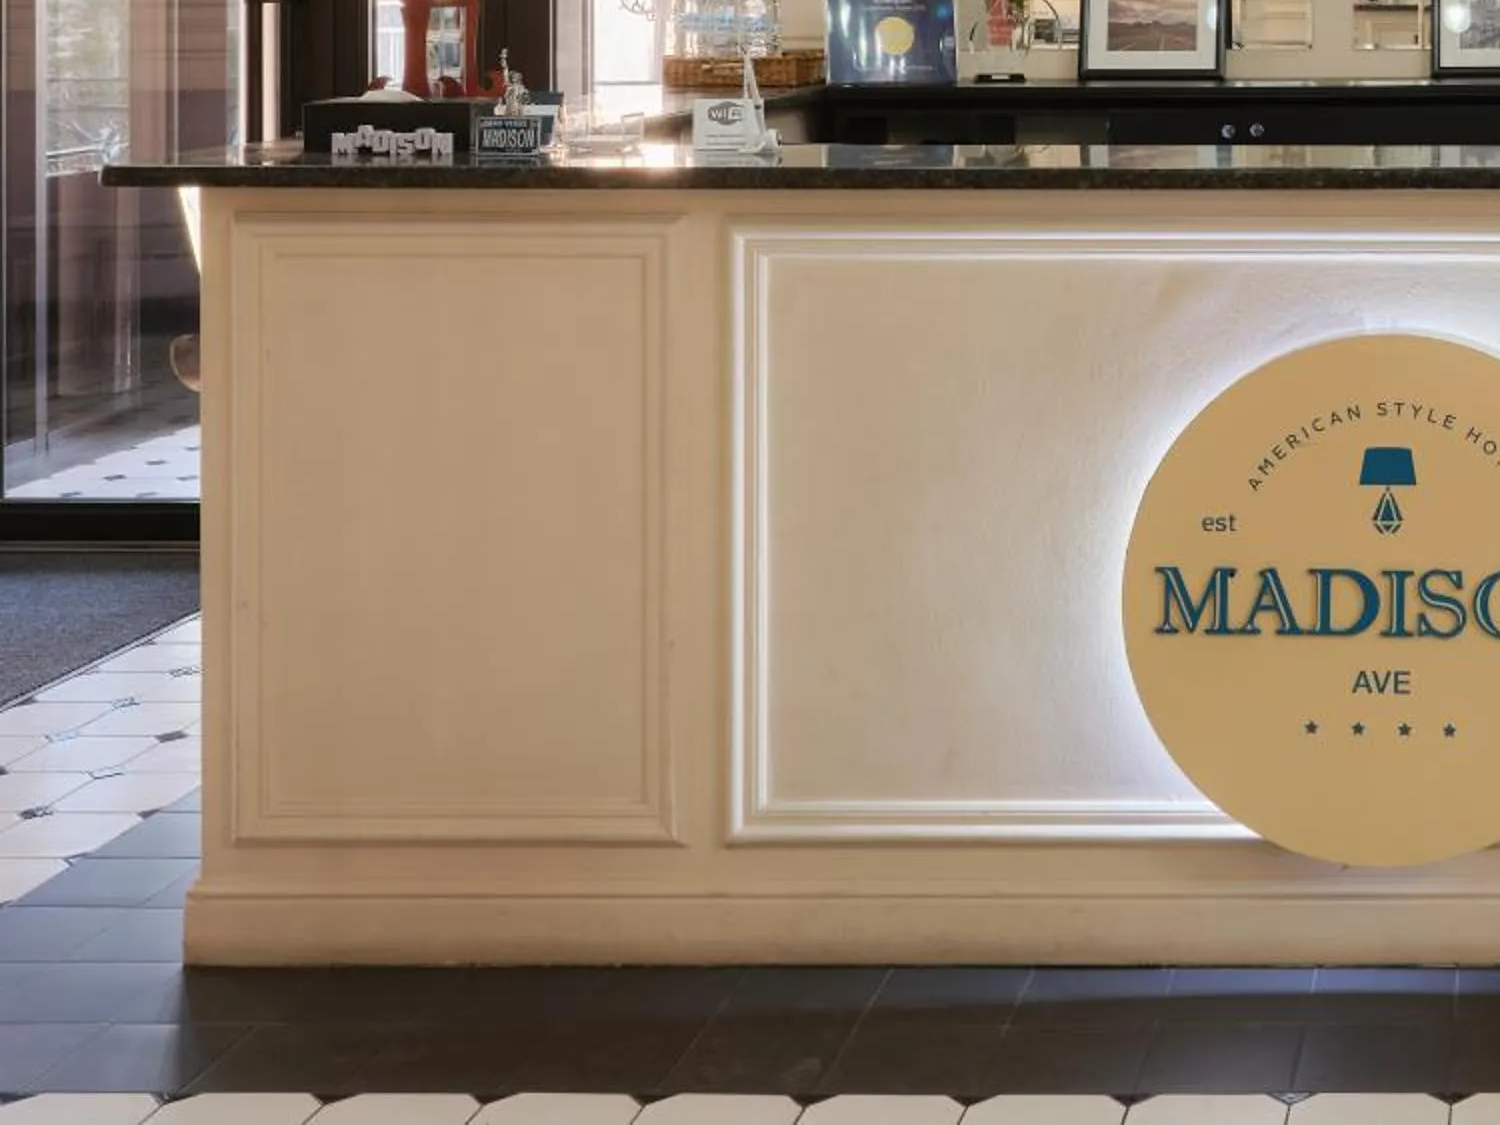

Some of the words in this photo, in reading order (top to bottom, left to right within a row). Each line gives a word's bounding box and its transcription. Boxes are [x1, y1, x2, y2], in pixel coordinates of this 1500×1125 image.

[332, 125, 454, 154] MADISON
[482, 128, 535, 148] MADISON
[1247, 404, 1362, 492] AMERICAN
[1376, 401, 1457, 431] STYLE
[1201, 513, 1237, 533] est
[1351, 669, 1412, 696] AVE
